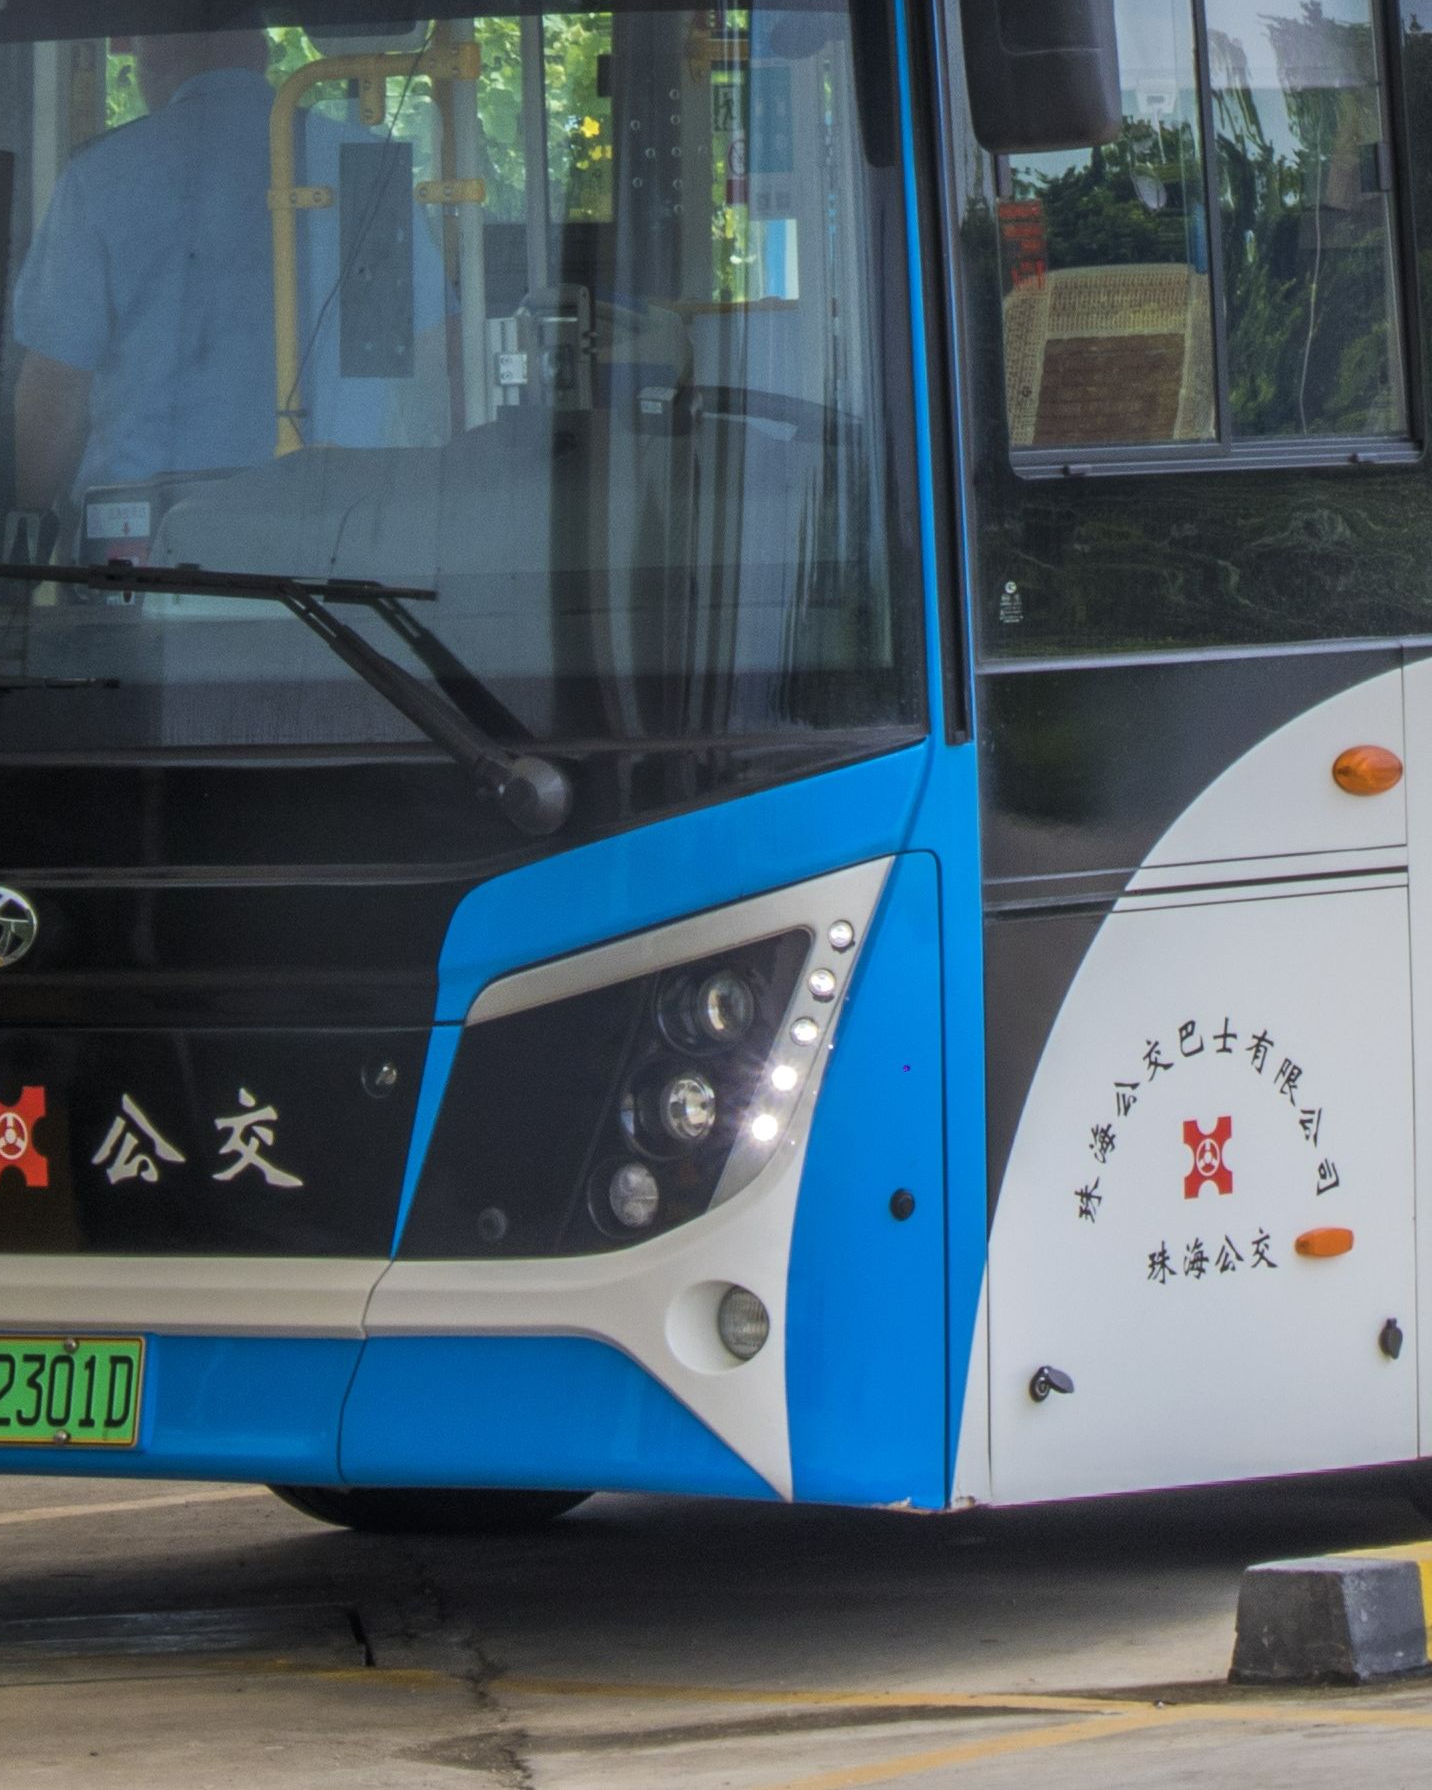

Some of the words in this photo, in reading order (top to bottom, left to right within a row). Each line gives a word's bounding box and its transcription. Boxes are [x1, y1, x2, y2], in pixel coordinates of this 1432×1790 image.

[91, 1087, 304, 1189] 公交
[1074, 1017, 1340, 1223] 珠海公交巴士有限公司
[1147, 1227, 1278, 1285] 珠海公交
